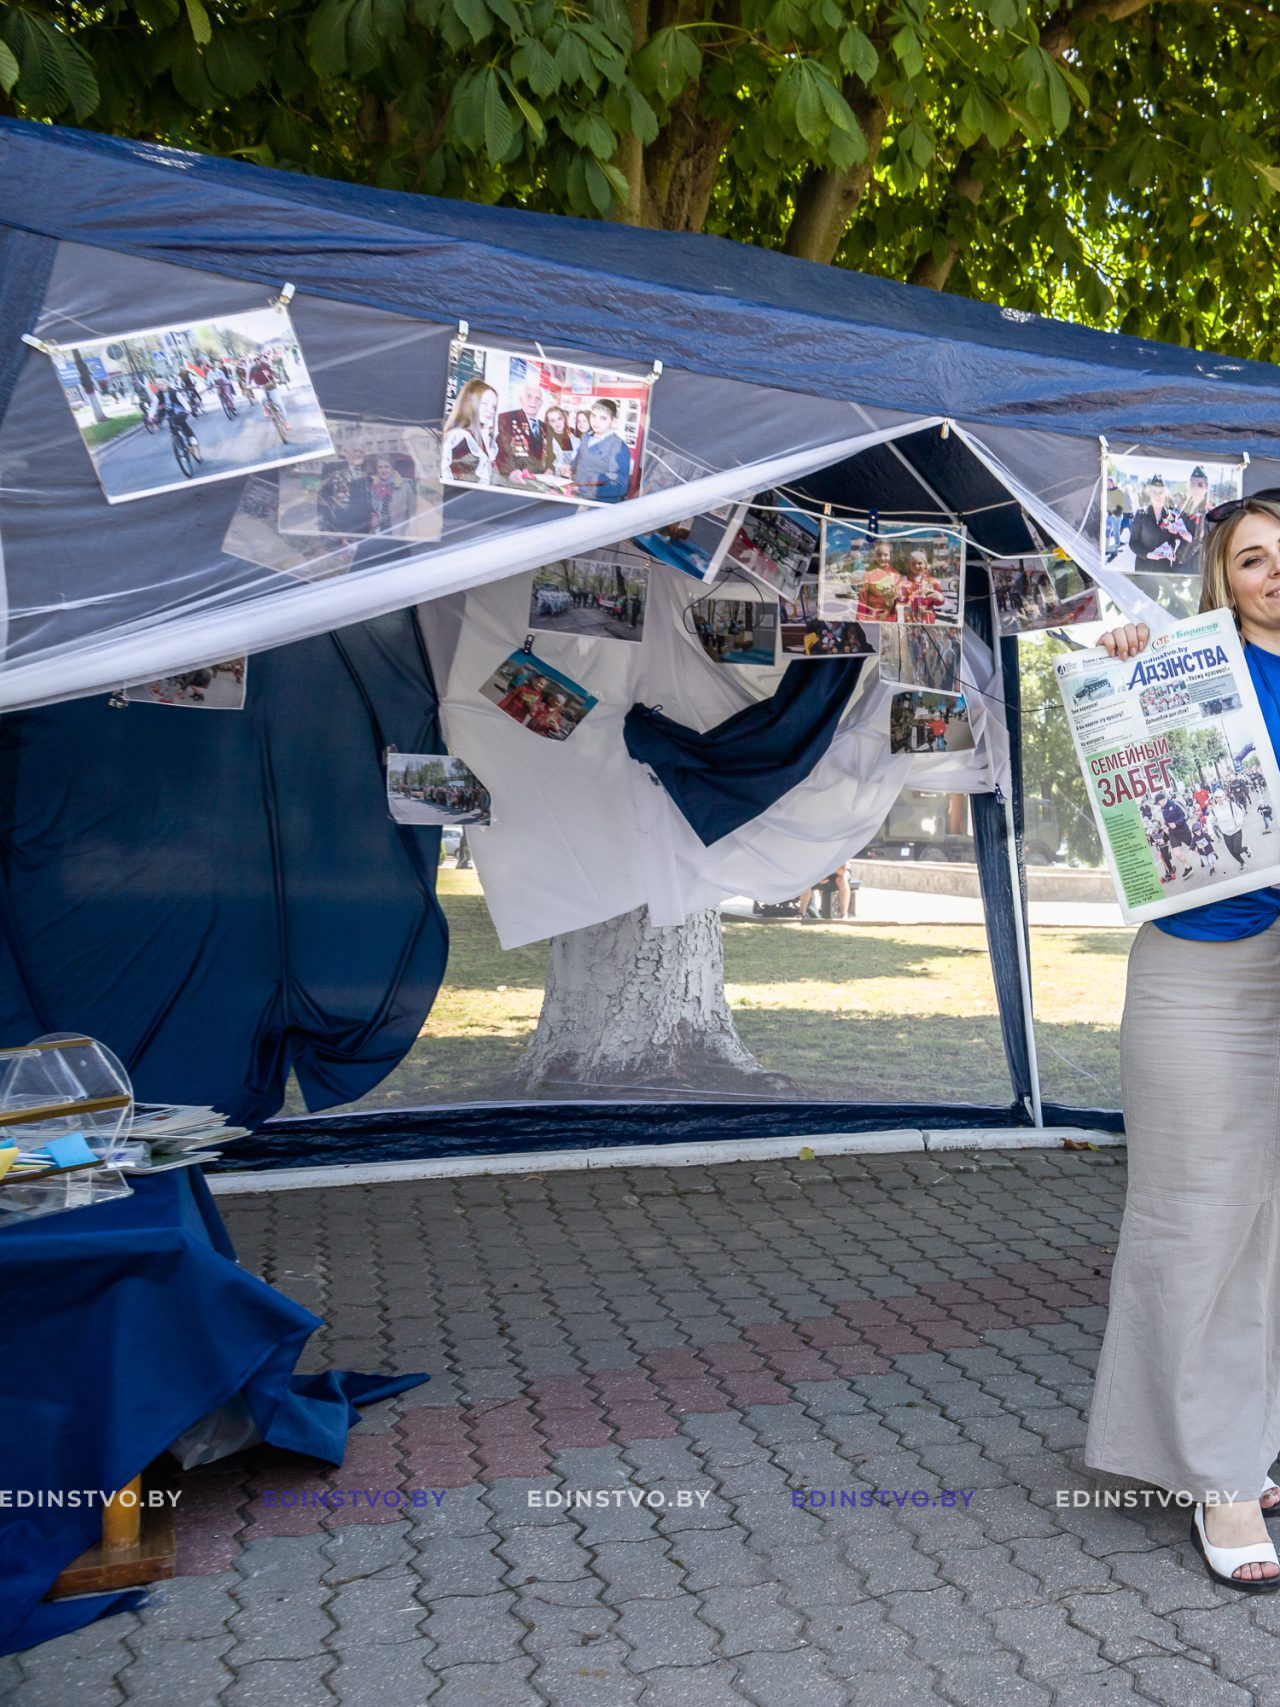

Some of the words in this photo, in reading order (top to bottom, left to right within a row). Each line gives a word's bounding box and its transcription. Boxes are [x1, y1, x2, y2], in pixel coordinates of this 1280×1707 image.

[1126, 645, 1229, 691] АДЗІНСТВА
[1142, 646, 1188, 665] edinstvo.by
[1090, 735, 1169, 776] СЕМЕЙНЫЙ
[1097, 758, 1172, 807] ЗАБЕГ
